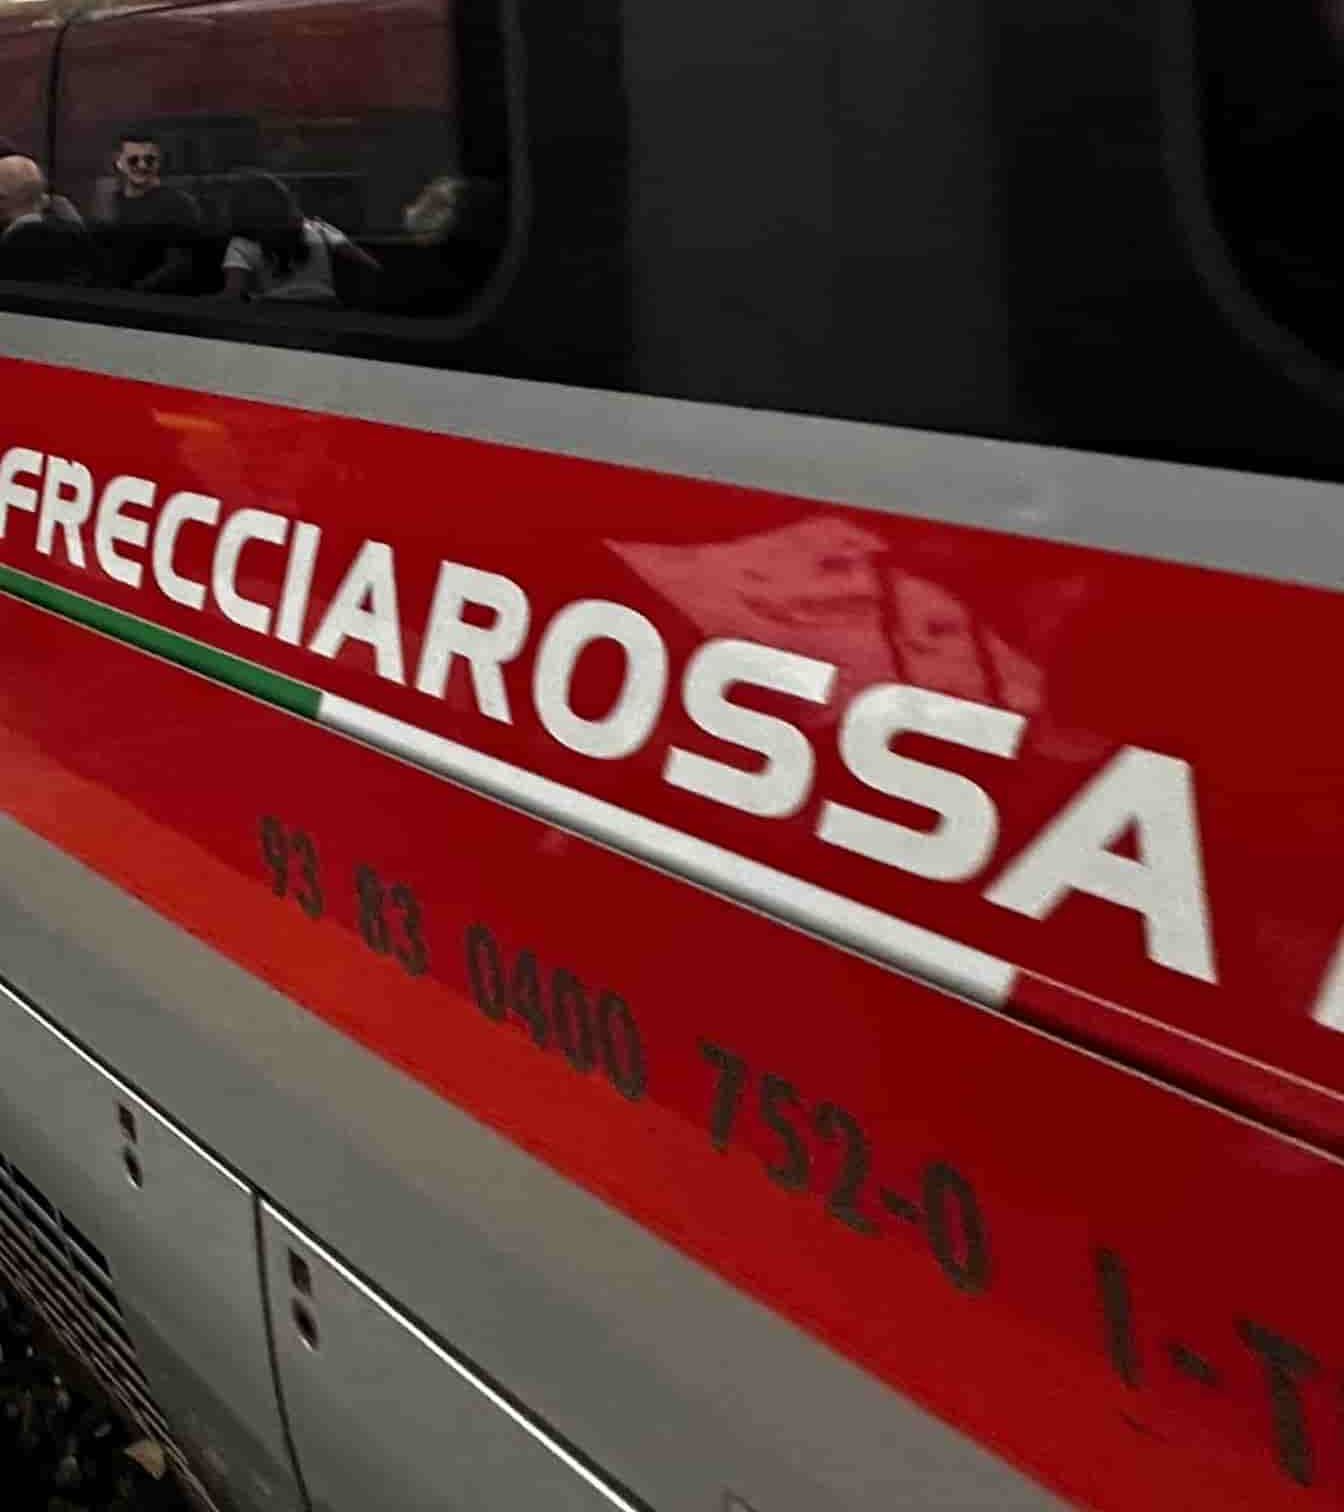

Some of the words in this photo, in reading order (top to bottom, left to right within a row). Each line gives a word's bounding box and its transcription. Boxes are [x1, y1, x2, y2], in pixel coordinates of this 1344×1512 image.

[259, 815, 323, 920] 93
[355, 861, 429, 976] 83
[466, 921, 648, 1103] 0400
[696, 1036, 990, 1295] 752-0
[1094, 1244, 1344, 1488] I-T
